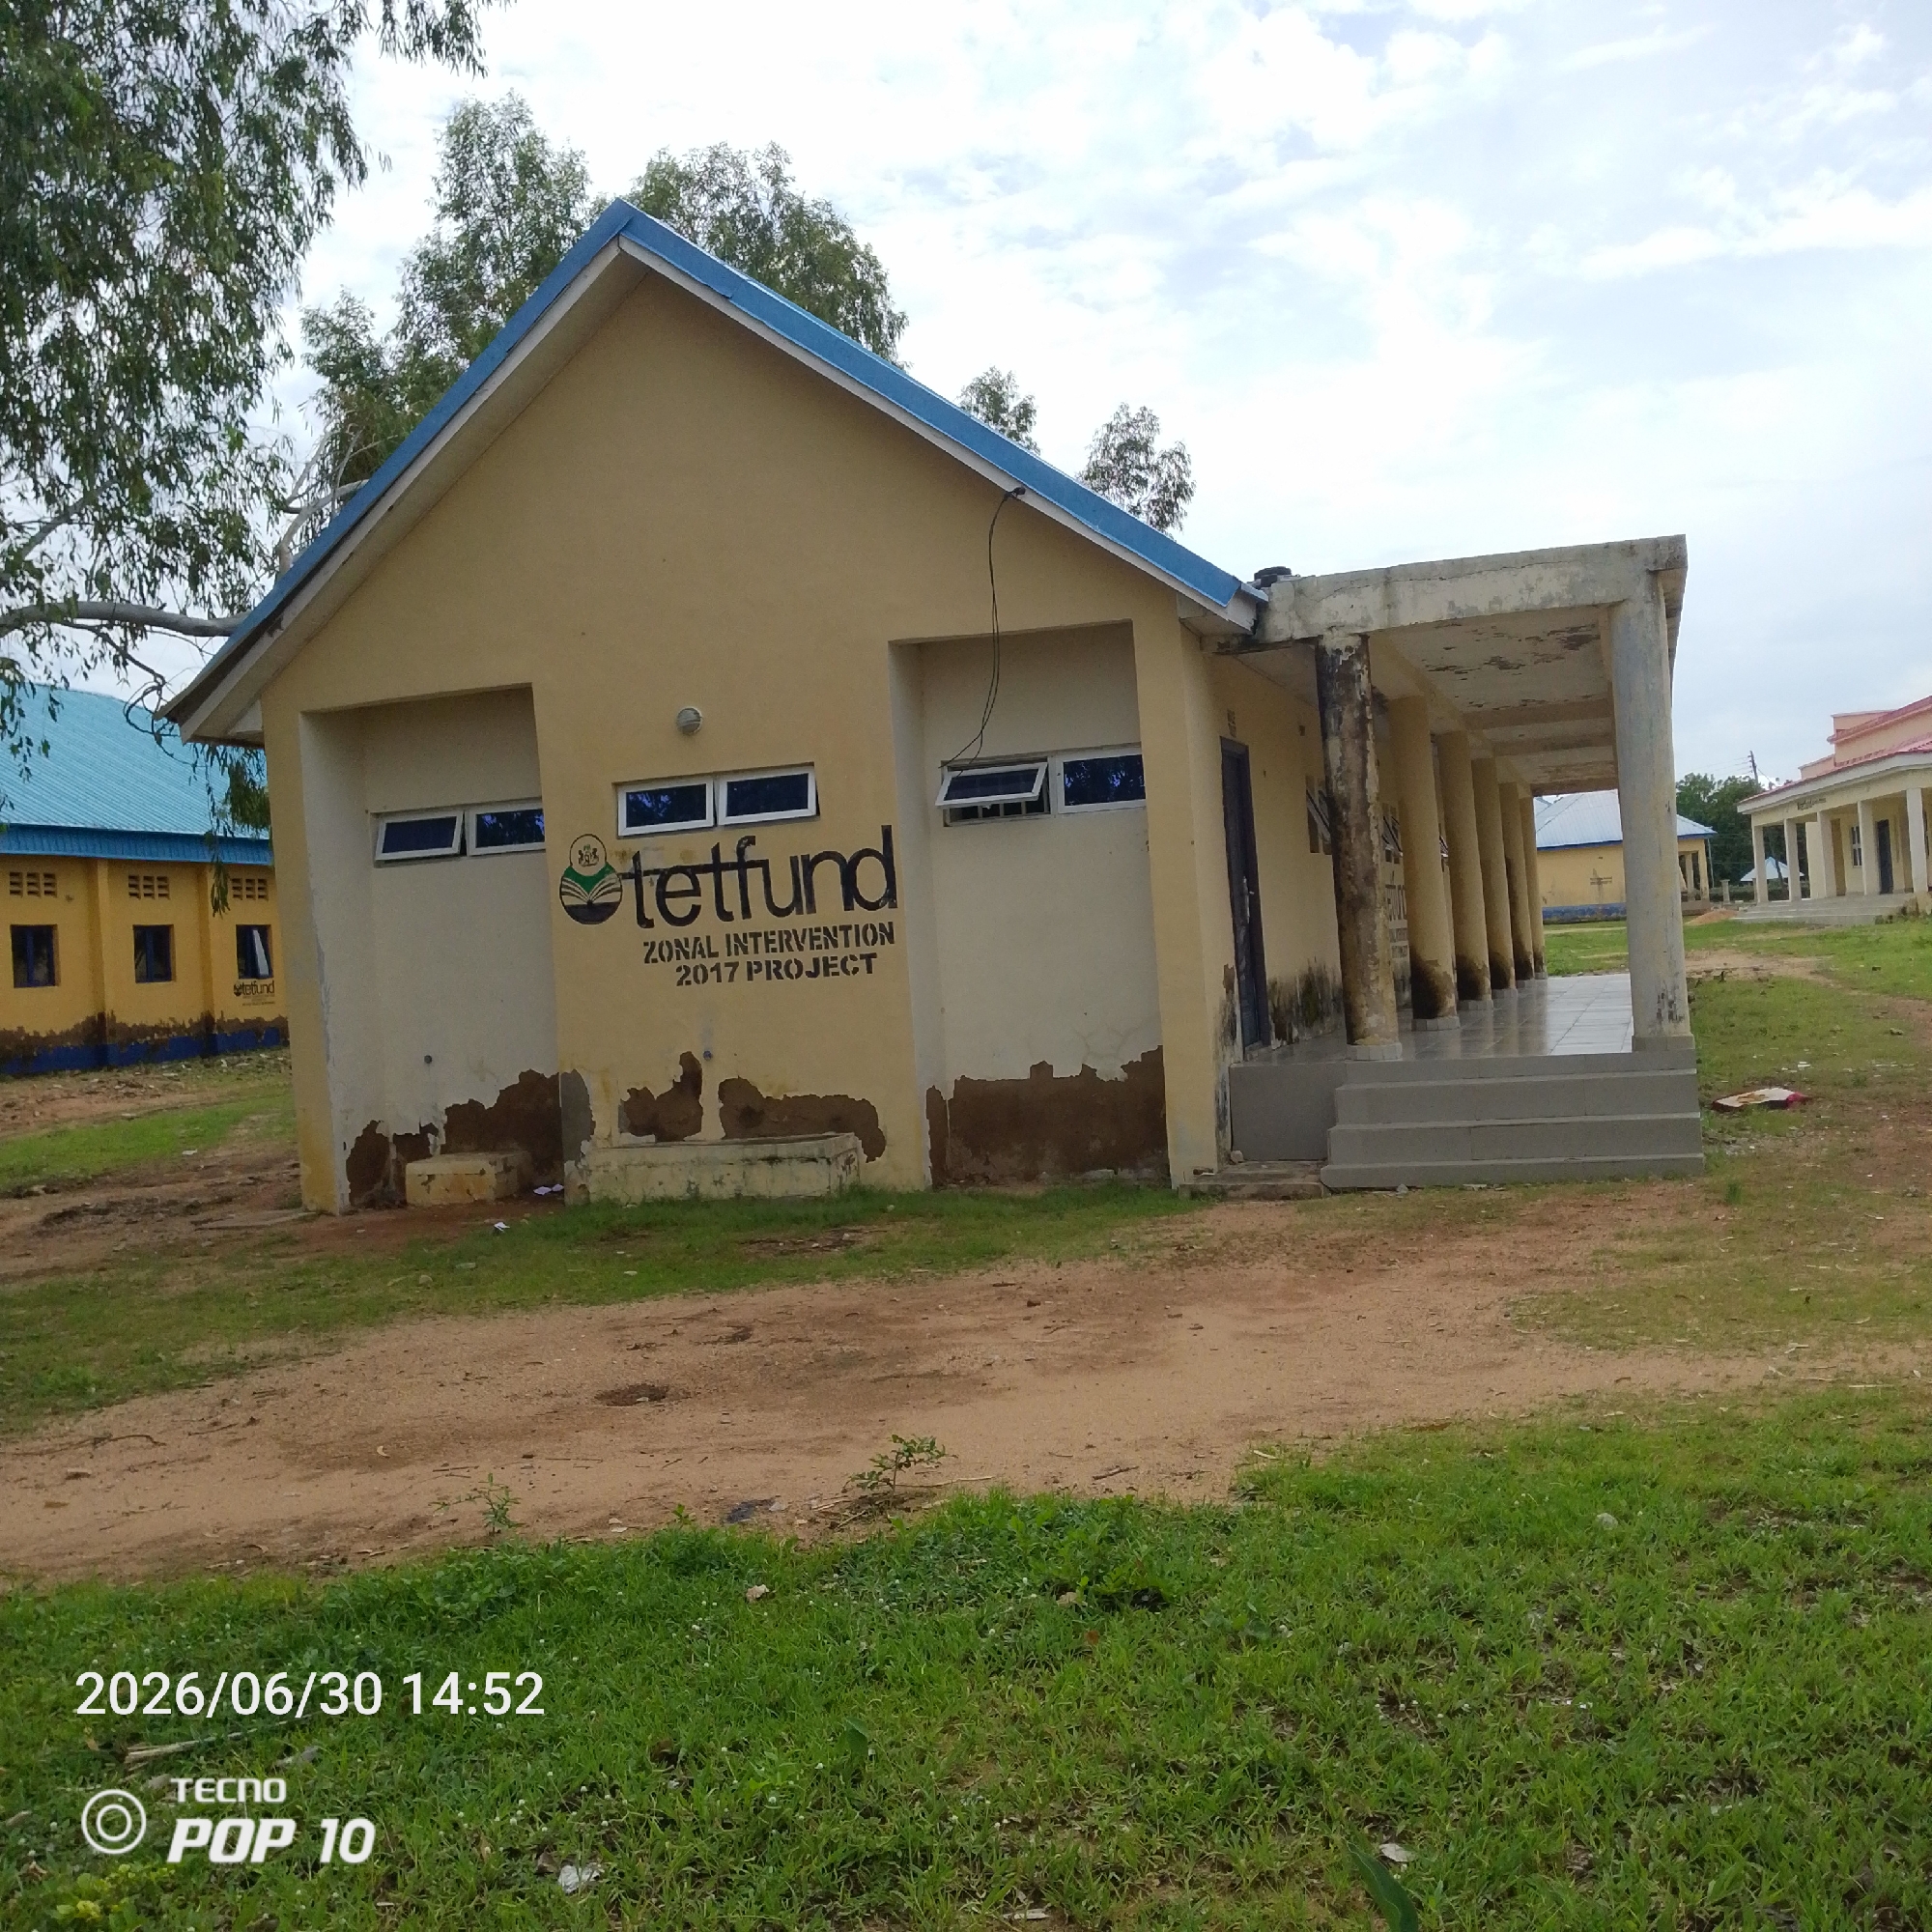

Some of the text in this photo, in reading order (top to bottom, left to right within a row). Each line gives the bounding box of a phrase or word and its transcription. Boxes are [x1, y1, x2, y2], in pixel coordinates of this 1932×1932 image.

[621, 825, 898, 928] tetfund
[643, 922, 895, 964] ZONAL INTERVENTION
[675, 952, 878, 986] 2017 PROJECT
